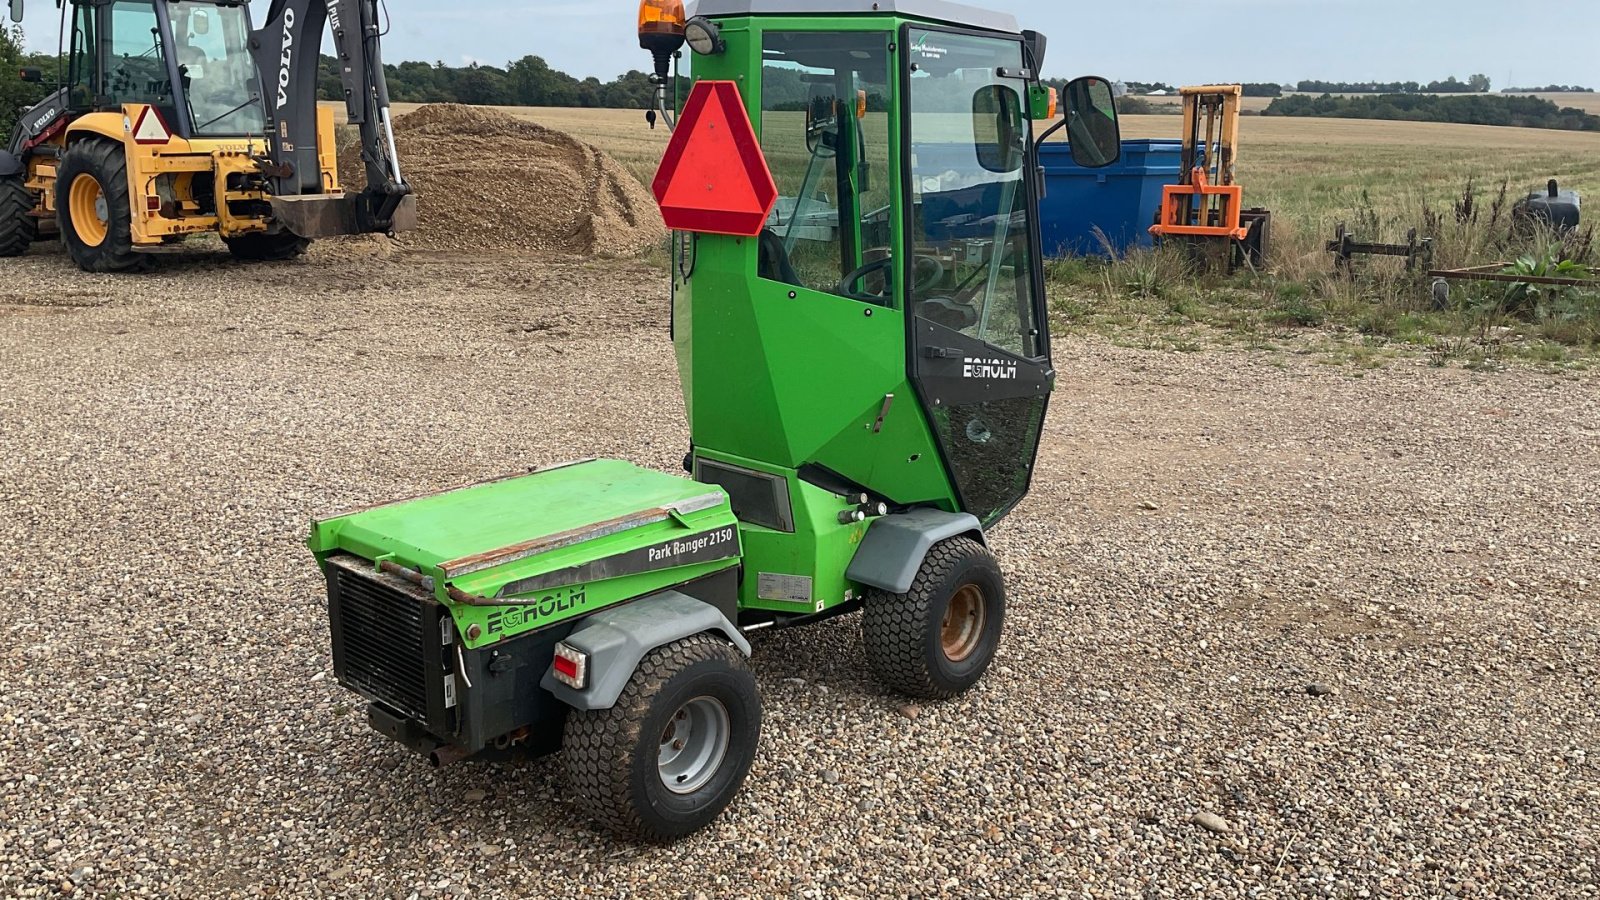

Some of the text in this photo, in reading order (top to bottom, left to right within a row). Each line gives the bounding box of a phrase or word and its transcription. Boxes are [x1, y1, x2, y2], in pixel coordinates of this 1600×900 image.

[328, 7, 341, 30] PLUS
[276, 8, 295, 109] VOLVO
[33, 108, 55, 128] VOLVO
[963, 357, 1017, 379] EGHOLM
[648, 528, 732, 562] Park Ranger 2150
[487, 585, 585, 634] EGHOLM
